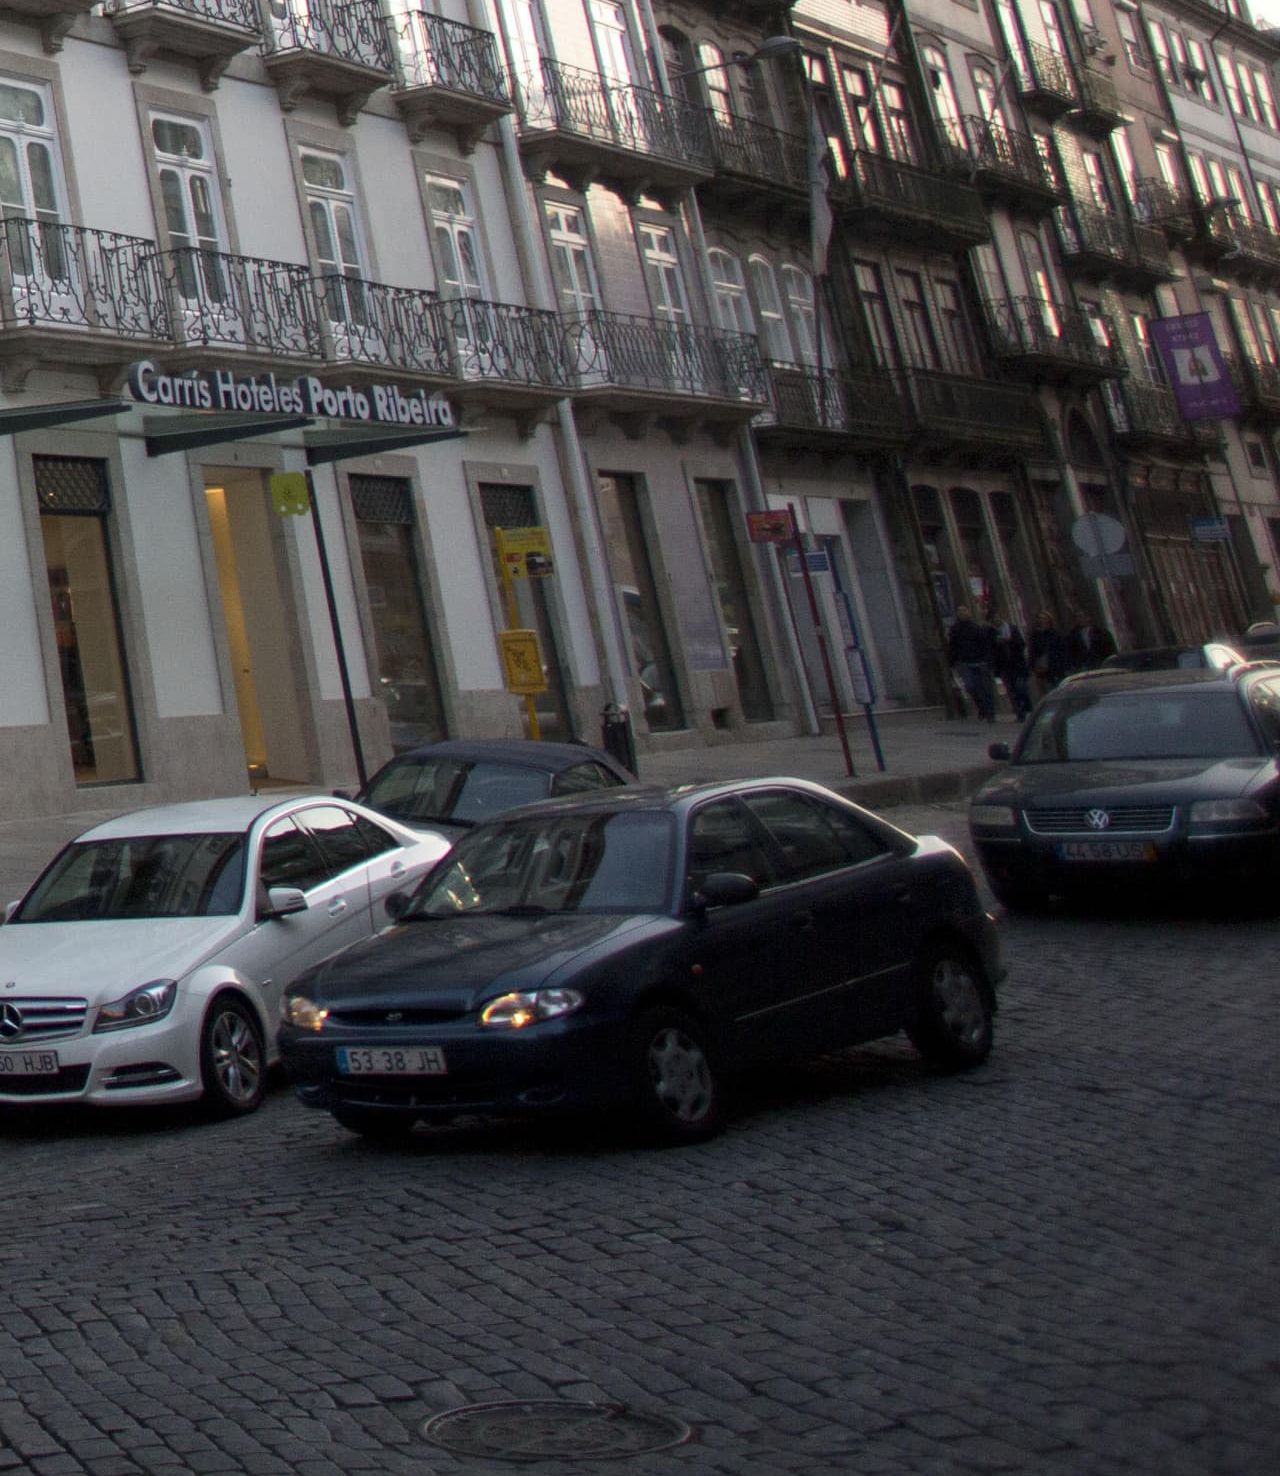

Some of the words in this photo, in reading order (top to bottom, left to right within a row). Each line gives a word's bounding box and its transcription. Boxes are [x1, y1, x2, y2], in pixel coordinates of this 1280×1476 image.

[135, 360, 212, 408] Carrís
[214, 370, 304, 414] Hoteles
[307, 376, 371, 420] Porto
[373, 385, 454, 427] Ribeira
[22, 1054, 54, 1072] HJB
